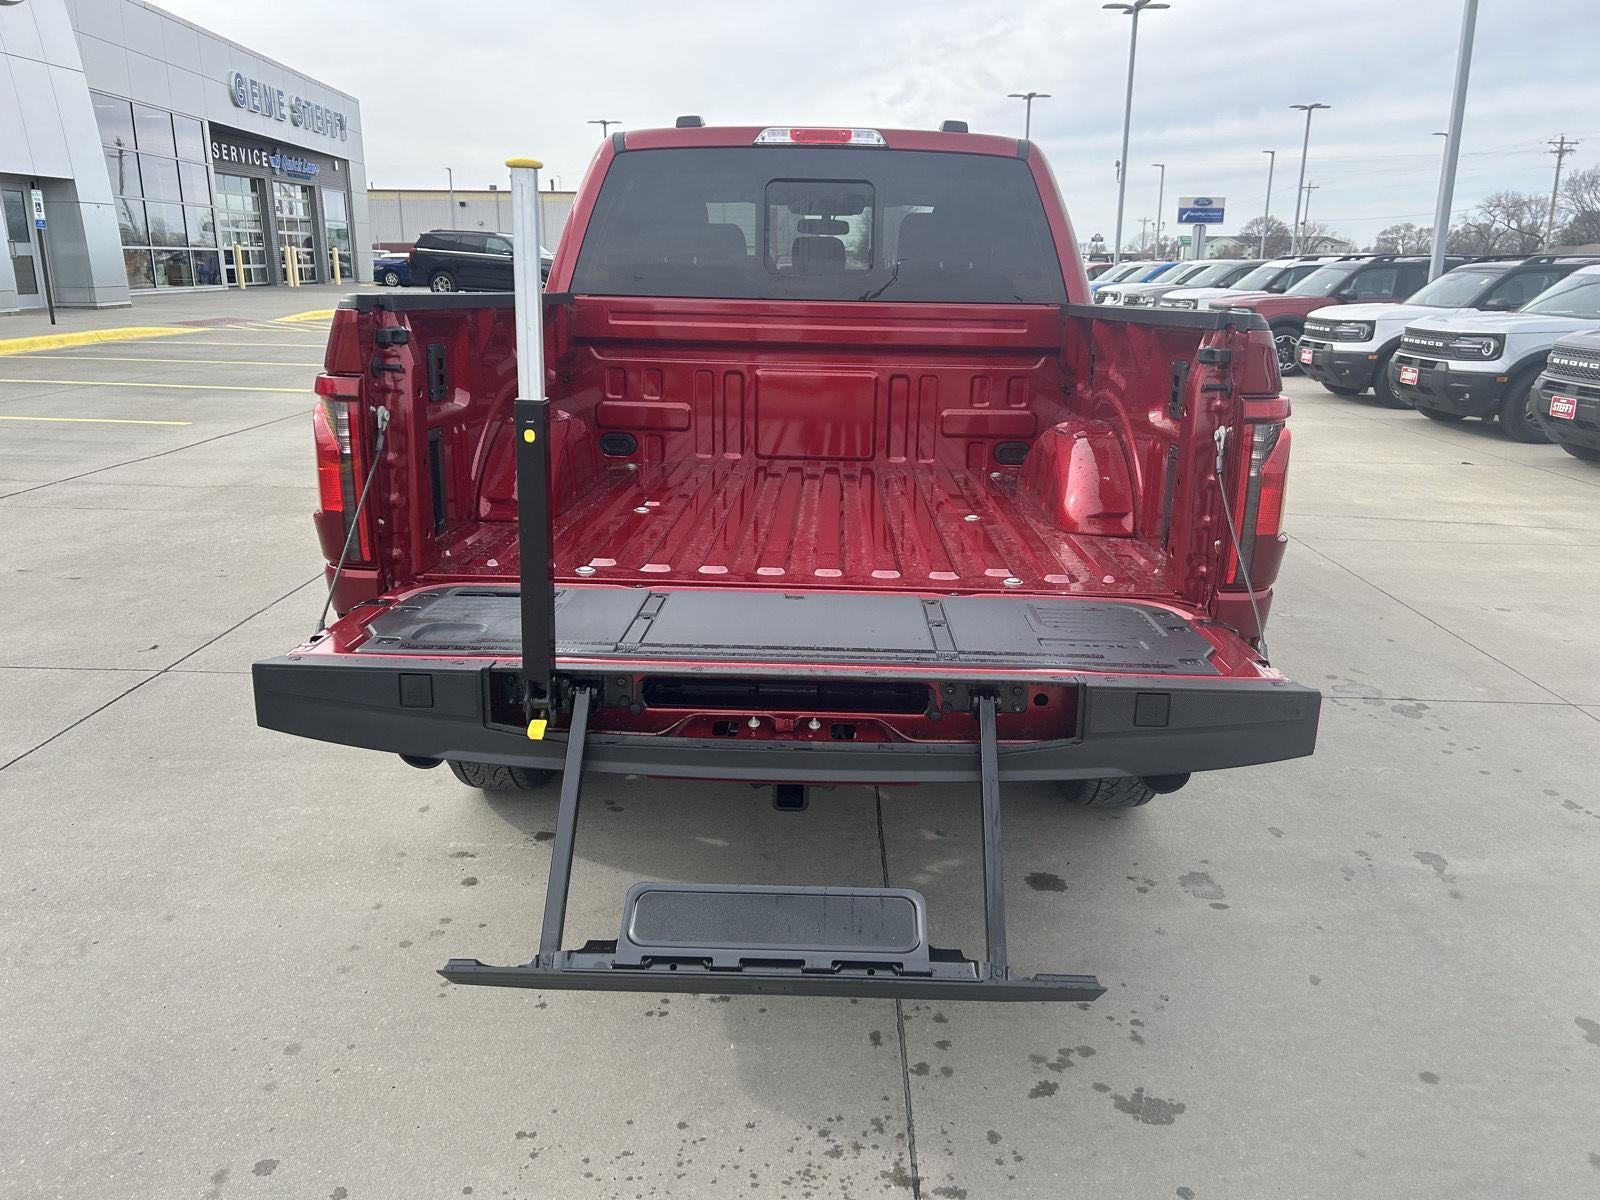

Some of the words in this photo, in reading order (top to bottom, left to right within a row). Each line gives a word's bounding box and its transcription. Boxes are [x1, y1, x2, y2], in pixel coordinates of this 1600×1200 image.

[231, 71, 286, 121] GENE
[291, 95, 347, 141] STEFFY
[212, 142, 269, 167] SERVICE
[281, 154, 302, 172] Quick
[303, 159, 320, 175] Lane
[1402, 337, 1443, 347] BRONCO
[1402, 371, 1417, 380] STEFFY
[1552, 401, 1574, 413] STEFFY
